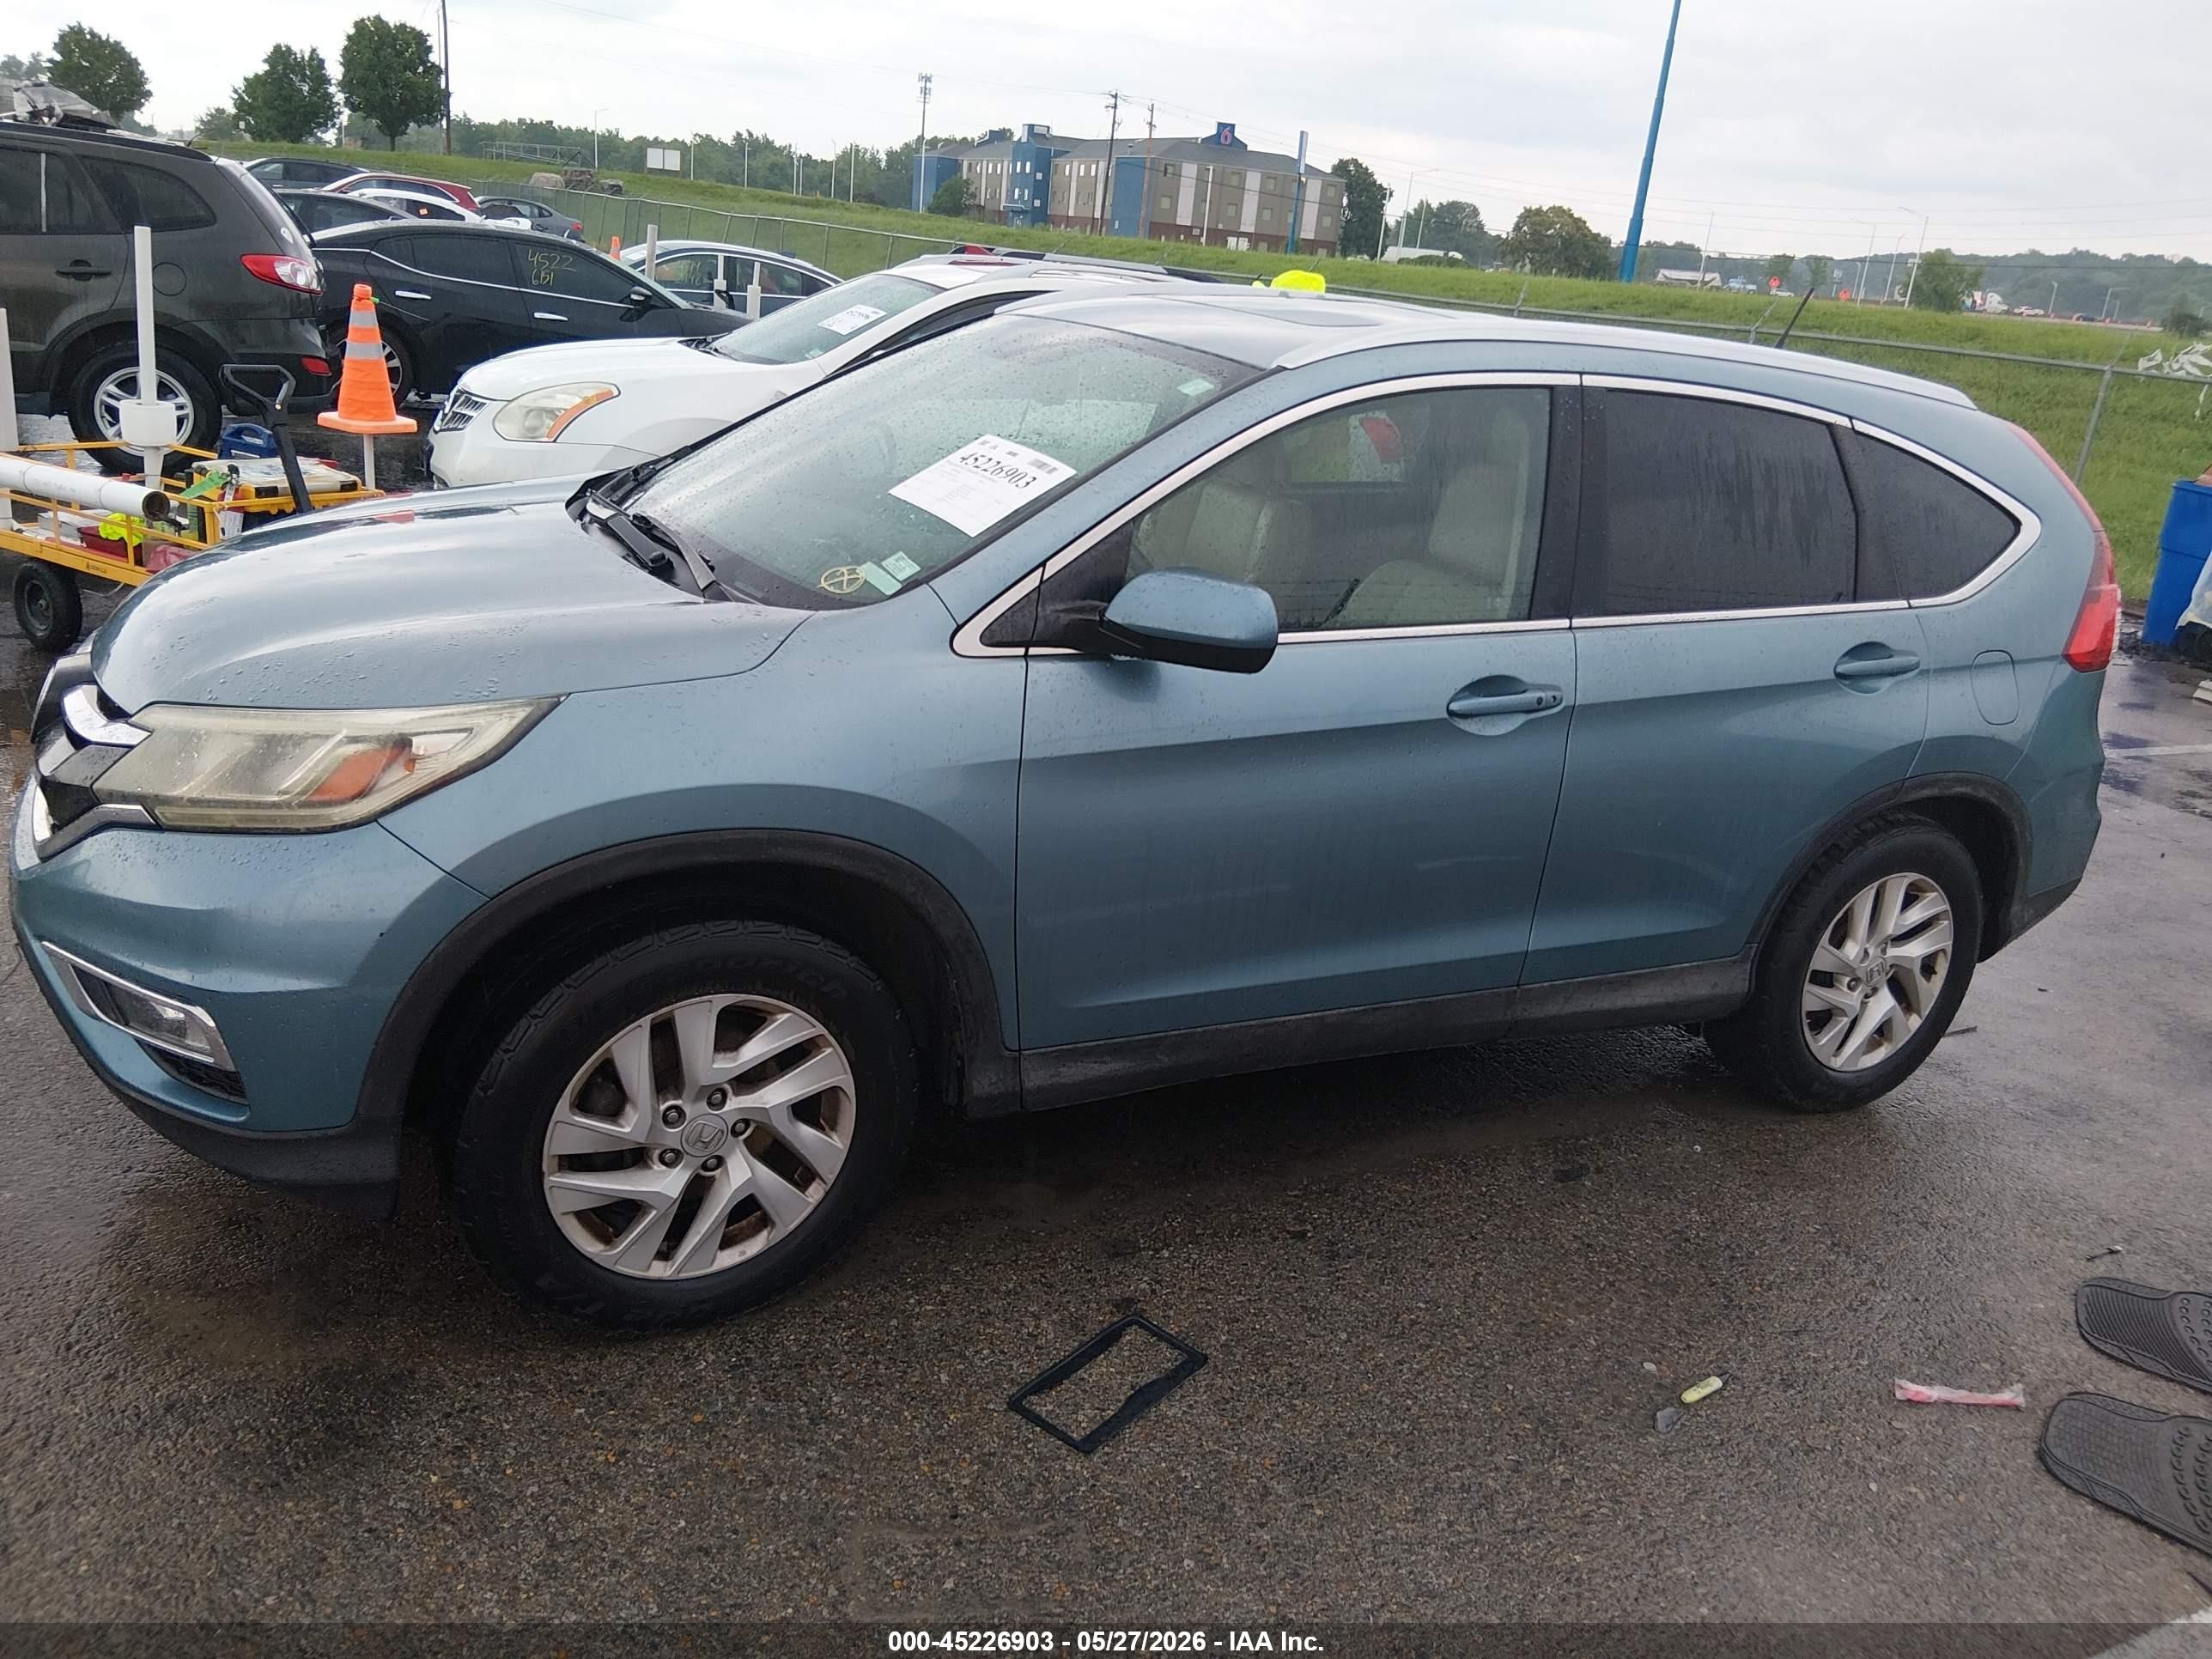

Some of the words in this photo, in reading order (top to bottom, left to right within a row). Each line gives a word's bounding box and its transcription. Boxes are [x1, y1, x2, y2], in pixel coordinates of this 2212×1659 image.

[1220, 126, 1231, 145] 6
[528, 248, 577, 272] 4522
[959, 452, 1037, 489] 45226903
